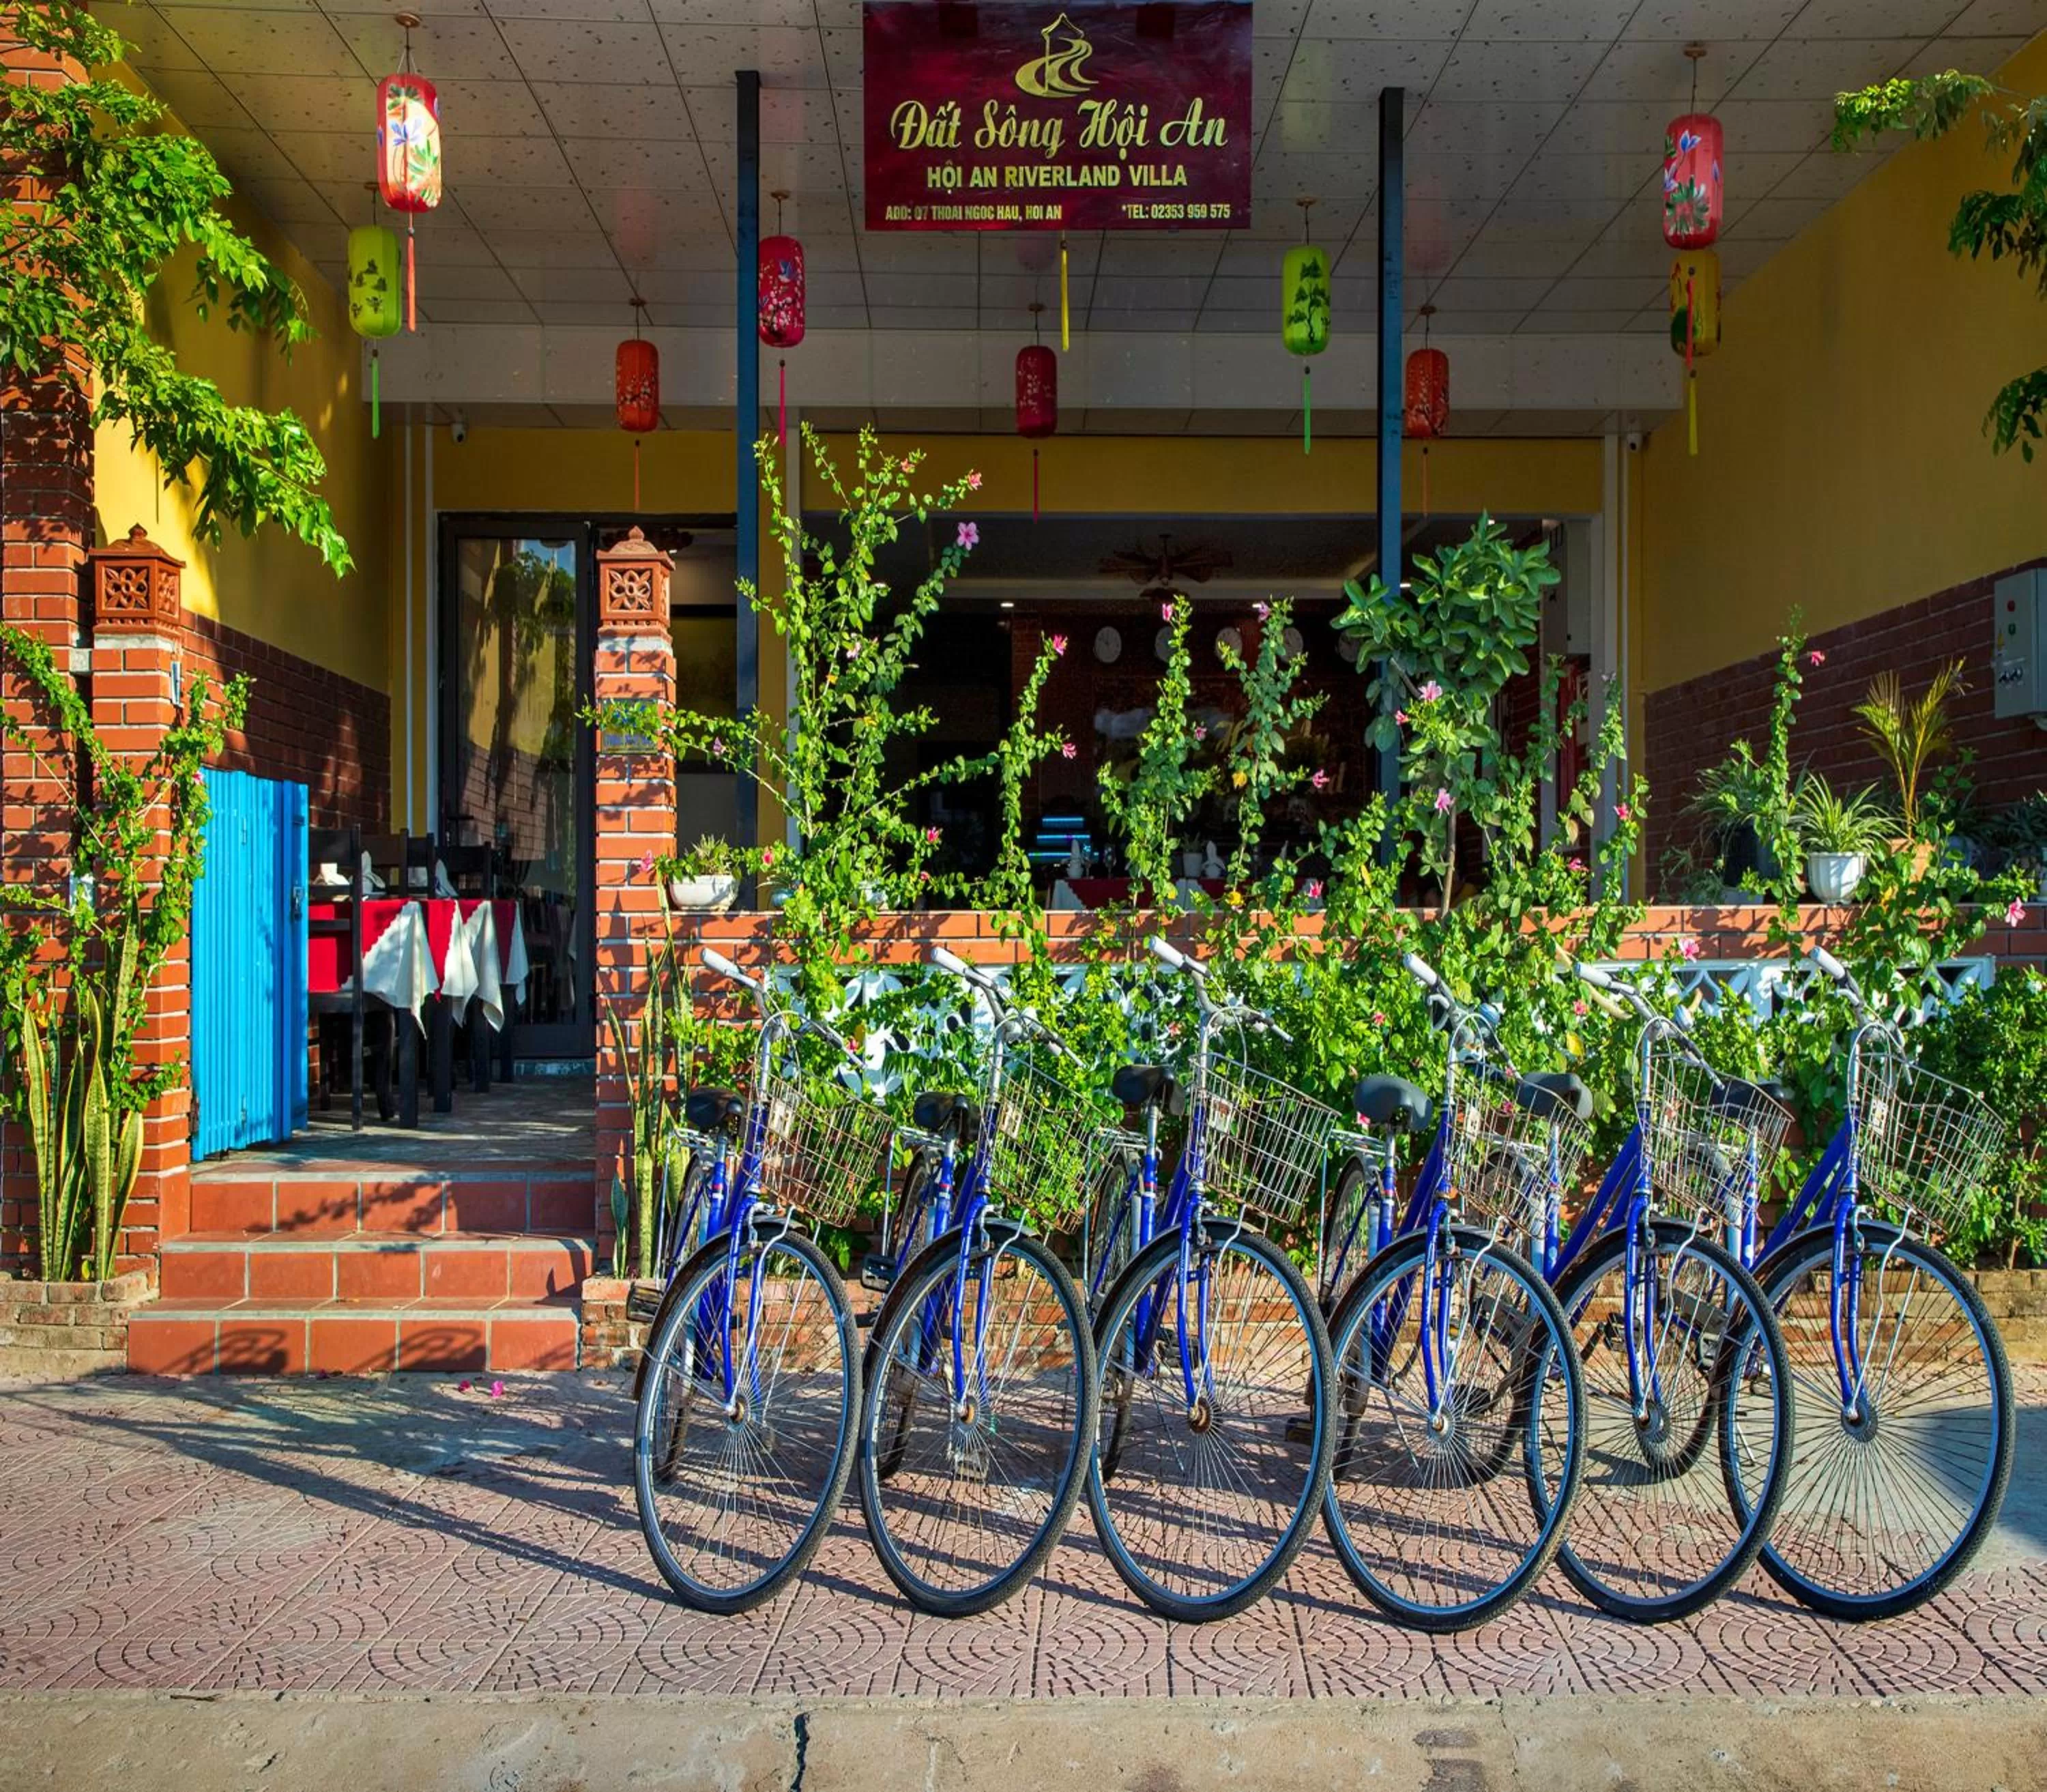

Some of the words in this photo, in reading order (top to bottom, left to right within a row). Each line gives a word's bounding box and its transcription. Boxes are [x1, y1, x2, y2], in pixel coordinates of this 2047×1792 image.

[890, 100, 961, 149] Đất
[974, 99, 1066, 159] Sông
[1077, 99, 1150, 160] Hội
[1160, 98, 1228, 146] An
[927, 160, 962, 194] HỘI
[970, 166, 997, 188] AN
[1005, 165, 1120, 188] RIVERLAND
[1129, 164, 1187, 186] VILLA
[1046, 205, 1062, 220] AN
[1151, 204, 1185, 219] 02353
[1187, 204, 1208, 219] 959
[1210, 204, 1231, 219] 575
